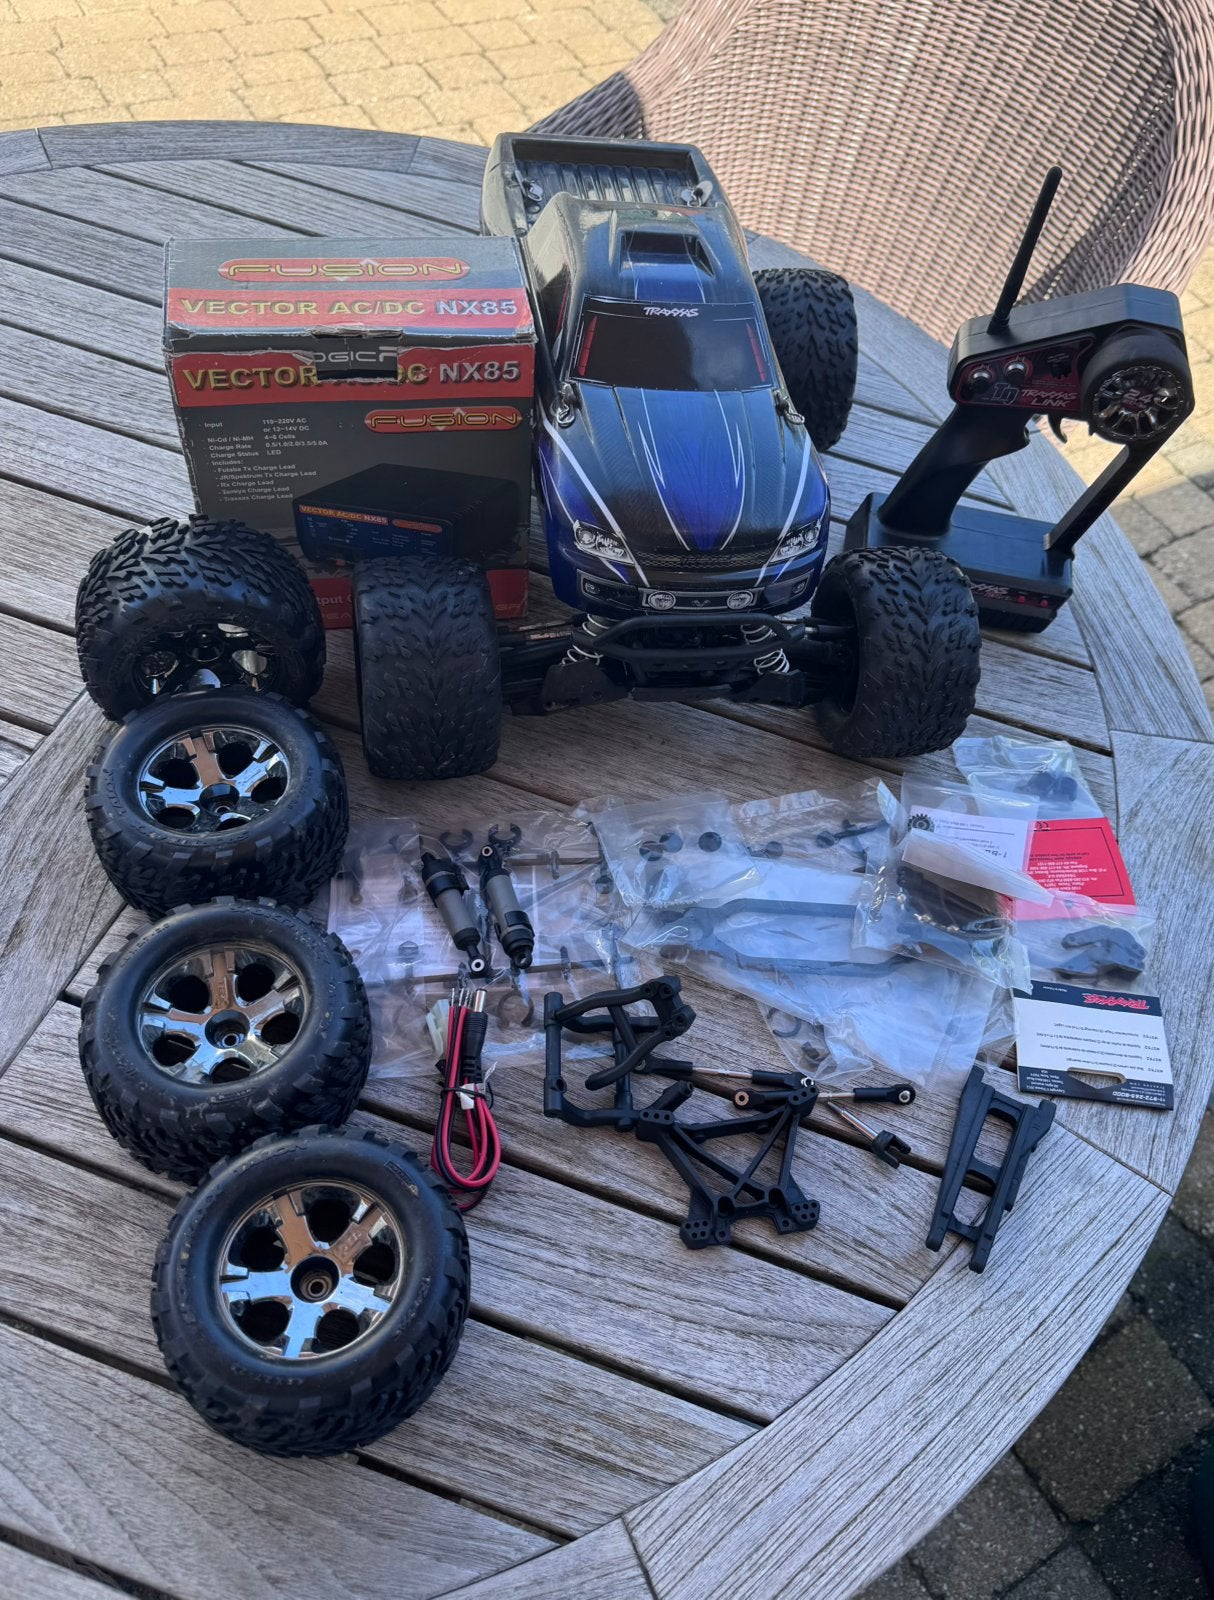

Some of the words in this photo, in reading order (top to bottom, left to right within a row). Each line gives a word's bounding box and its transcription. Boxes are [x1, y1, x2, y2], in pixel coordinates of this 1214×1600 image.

[228, 263, 462, 277] FUSION
[181, 299, 319, 315] VECTOR
[328, 300, 425, 315] AC/DC
[435, 299, 518, 315] NX85
[643, 306, 699, 317] TRAXXAS
[182, 364, 320, 390] VECTOR
[439, 360, 520, 384] NX85
[1021, 388, 1078, 400] TRAXXAS
[1031, 398, 1070, 408] LINK
[370, 412, 518, 428] FUSION
[315, 594, 343, 607] tput
[1082, 993, 1150, 1010] TRAXXAS
